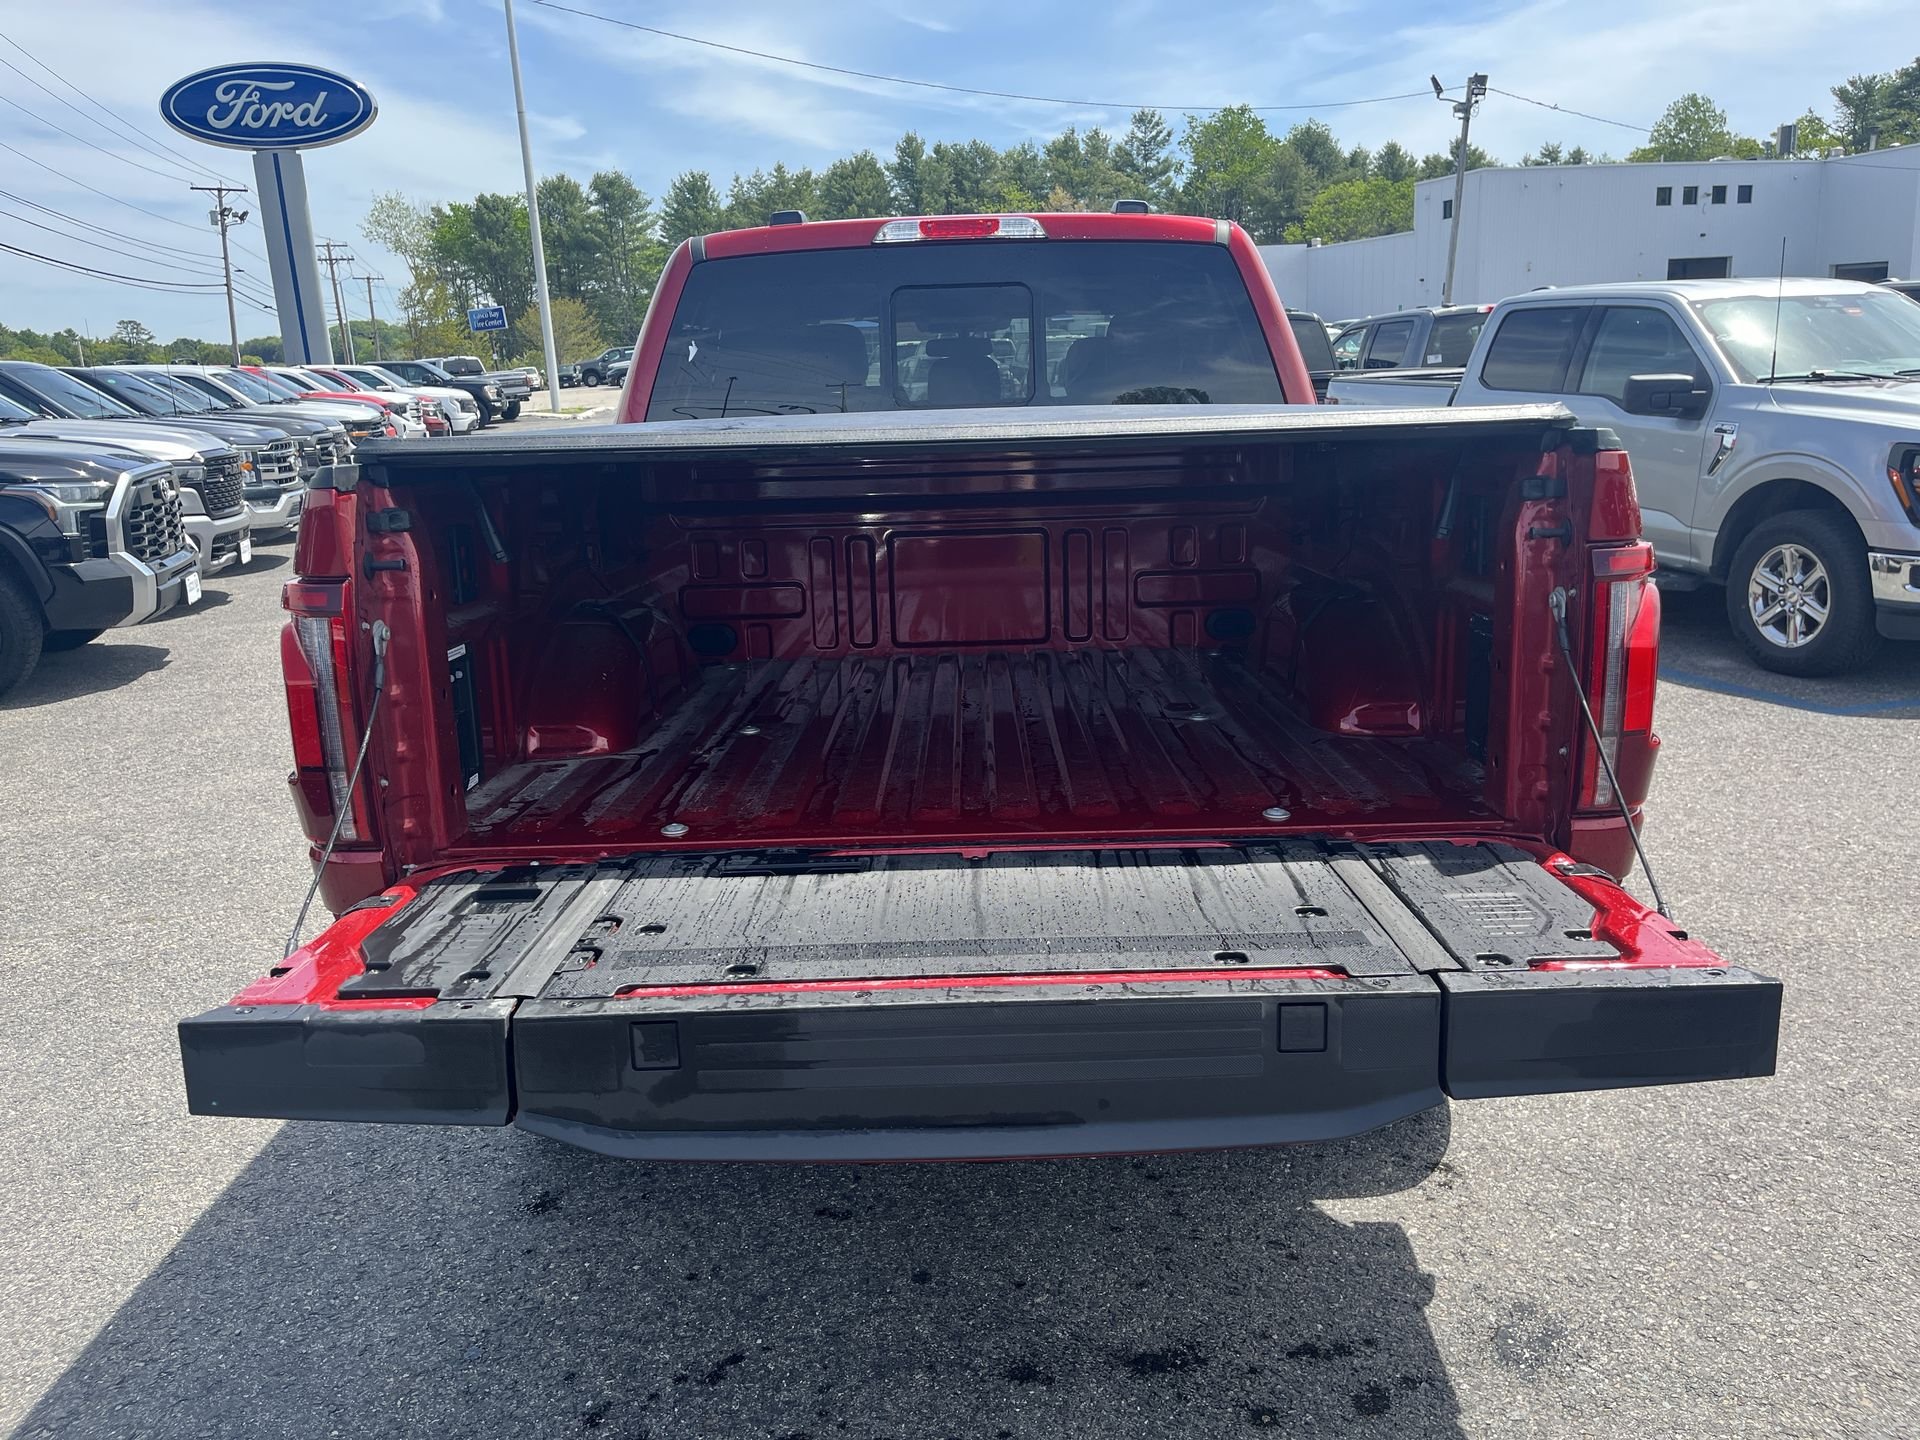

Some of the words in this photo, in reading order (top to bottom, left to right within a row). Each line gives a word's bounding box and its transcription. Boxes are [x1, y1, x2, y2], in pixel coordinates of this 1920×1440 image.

[206, 79, 328, 129] Ford
[489, 311, 500, 319] Bay
[485, 319, 502, 327] Center
